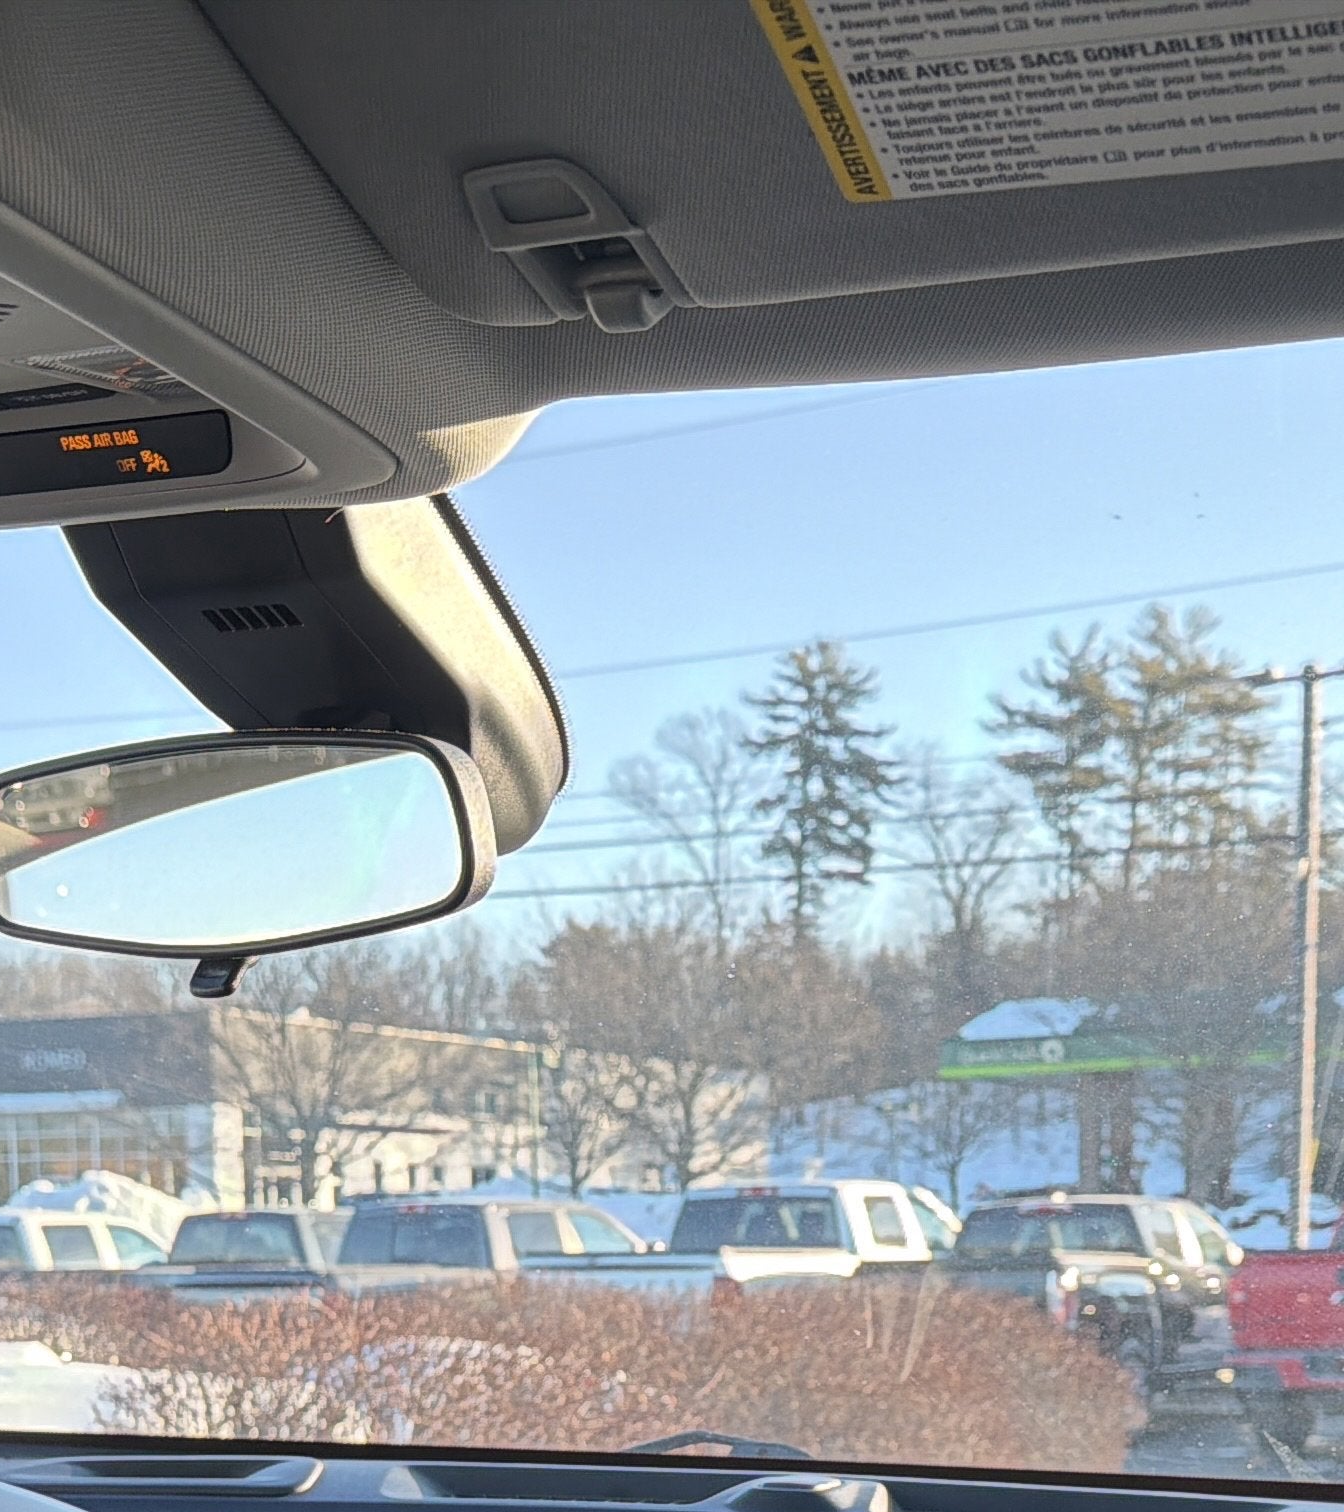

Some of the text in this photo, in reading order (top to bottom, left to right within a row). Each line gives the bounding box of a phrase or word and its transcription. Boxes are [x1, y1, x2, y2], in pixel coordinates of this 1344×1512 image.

[846, 66, 910, 87] MÊME
[916, 59, 969, 80] AVEC
[973, 55, 1016, 74] DES
[1021, 47, 1078, 69] SACS
[1083, 33, 1225, 63] GONFLABLES
[801, 69, 879, 197] AVERTISSEMENT
[59, 429, 139, 451] PASS AIR BAG
[116, 457, 137, 472] OFF
